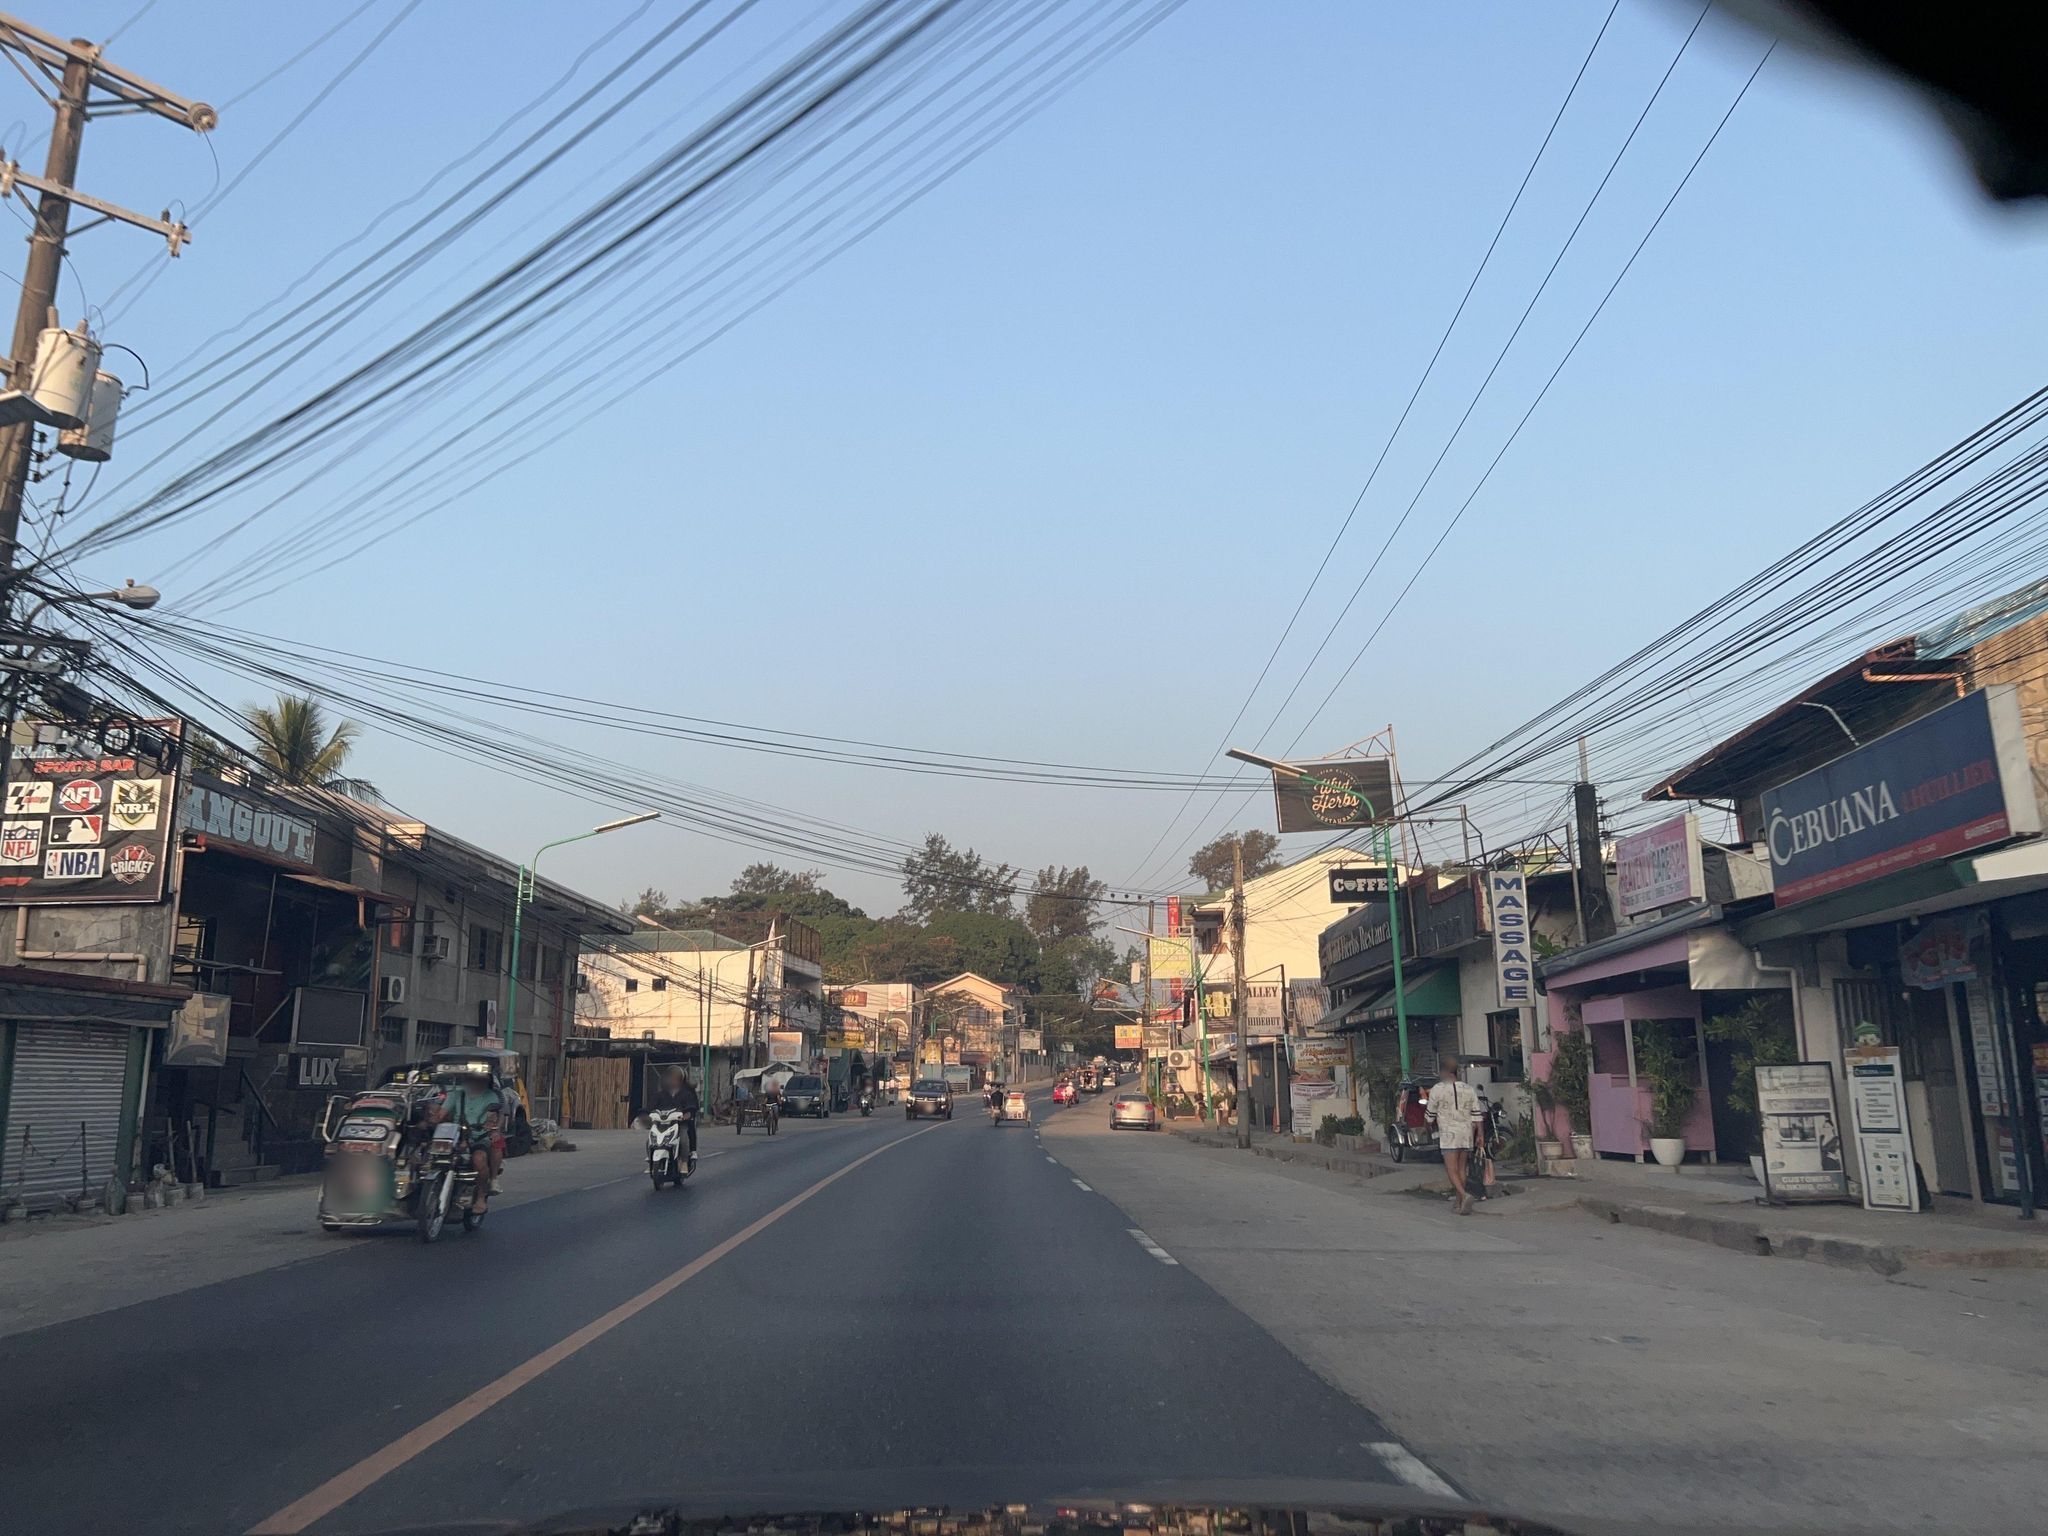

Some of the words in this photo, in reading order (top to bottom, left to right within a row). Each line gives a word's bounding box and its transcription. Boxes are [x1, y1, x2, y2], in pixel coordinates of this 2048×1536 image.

[34, 759, 97, 774] SPORTS
[100, 759, 136, 772] BAR
[1313, 777, 1353, 795] Wild
[58, 786, 102, 805] AFL
[1312, 793, 1360, 813] Herbs
[114, 803, 153, 814] NRL
[1316, 808, 1358, 824] RESTAURANT
[1769, 780, 1900, 867] CEBUANA
[4, 841, 34, 856] NFL
[60, 851, 100, 876] NBA
[111, 859, 155, 875] CRICKET
[1358, 920, 1391, 951] Restaura
[1494, 877, 1529, 1000] MASSAGE
[1247, 986, 1278, 998] ALLEY
[1248, 1017, 1281, 1027] HIDEOUT
[299, 1057, 340, 1085] LUX
